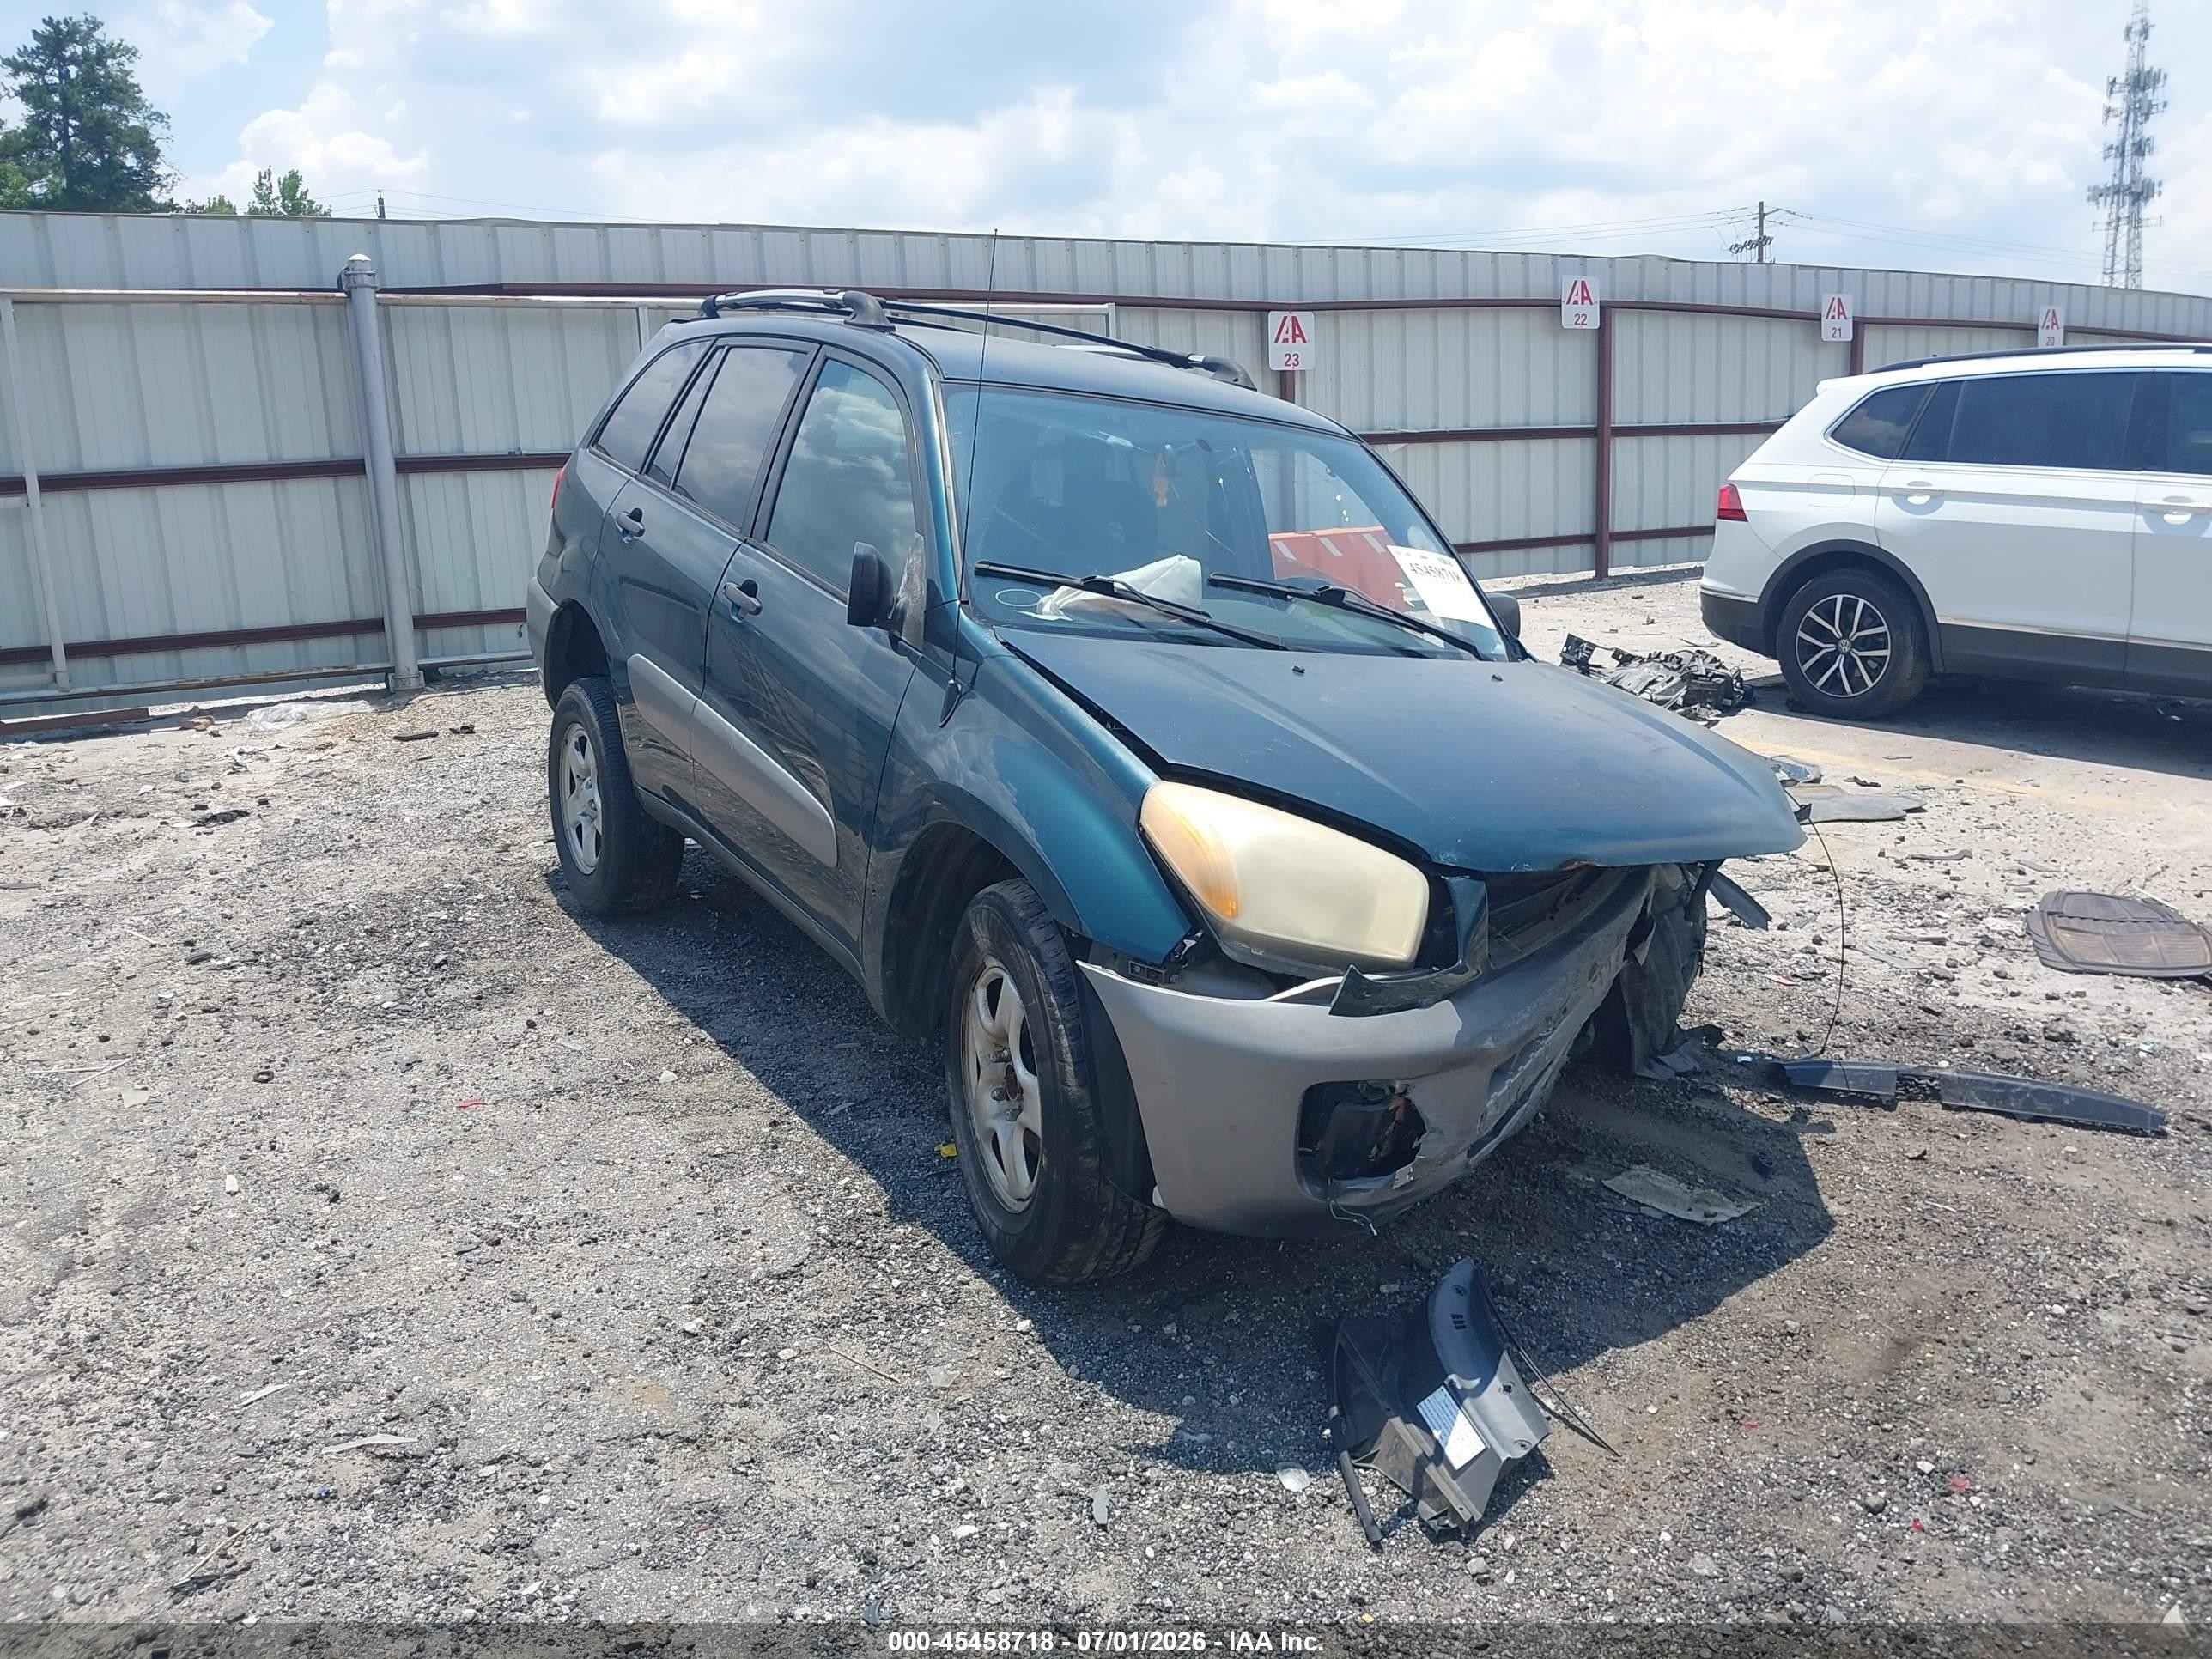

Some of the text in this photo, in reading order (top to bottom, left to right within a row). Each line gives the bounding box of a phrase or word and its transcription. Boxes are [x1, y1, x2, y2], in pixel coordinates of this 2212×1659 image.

[1574, 313, 1588, 325] 22
[1831, 326, 1843, 338] 21
[1284, 353, 1300, 368] 23
